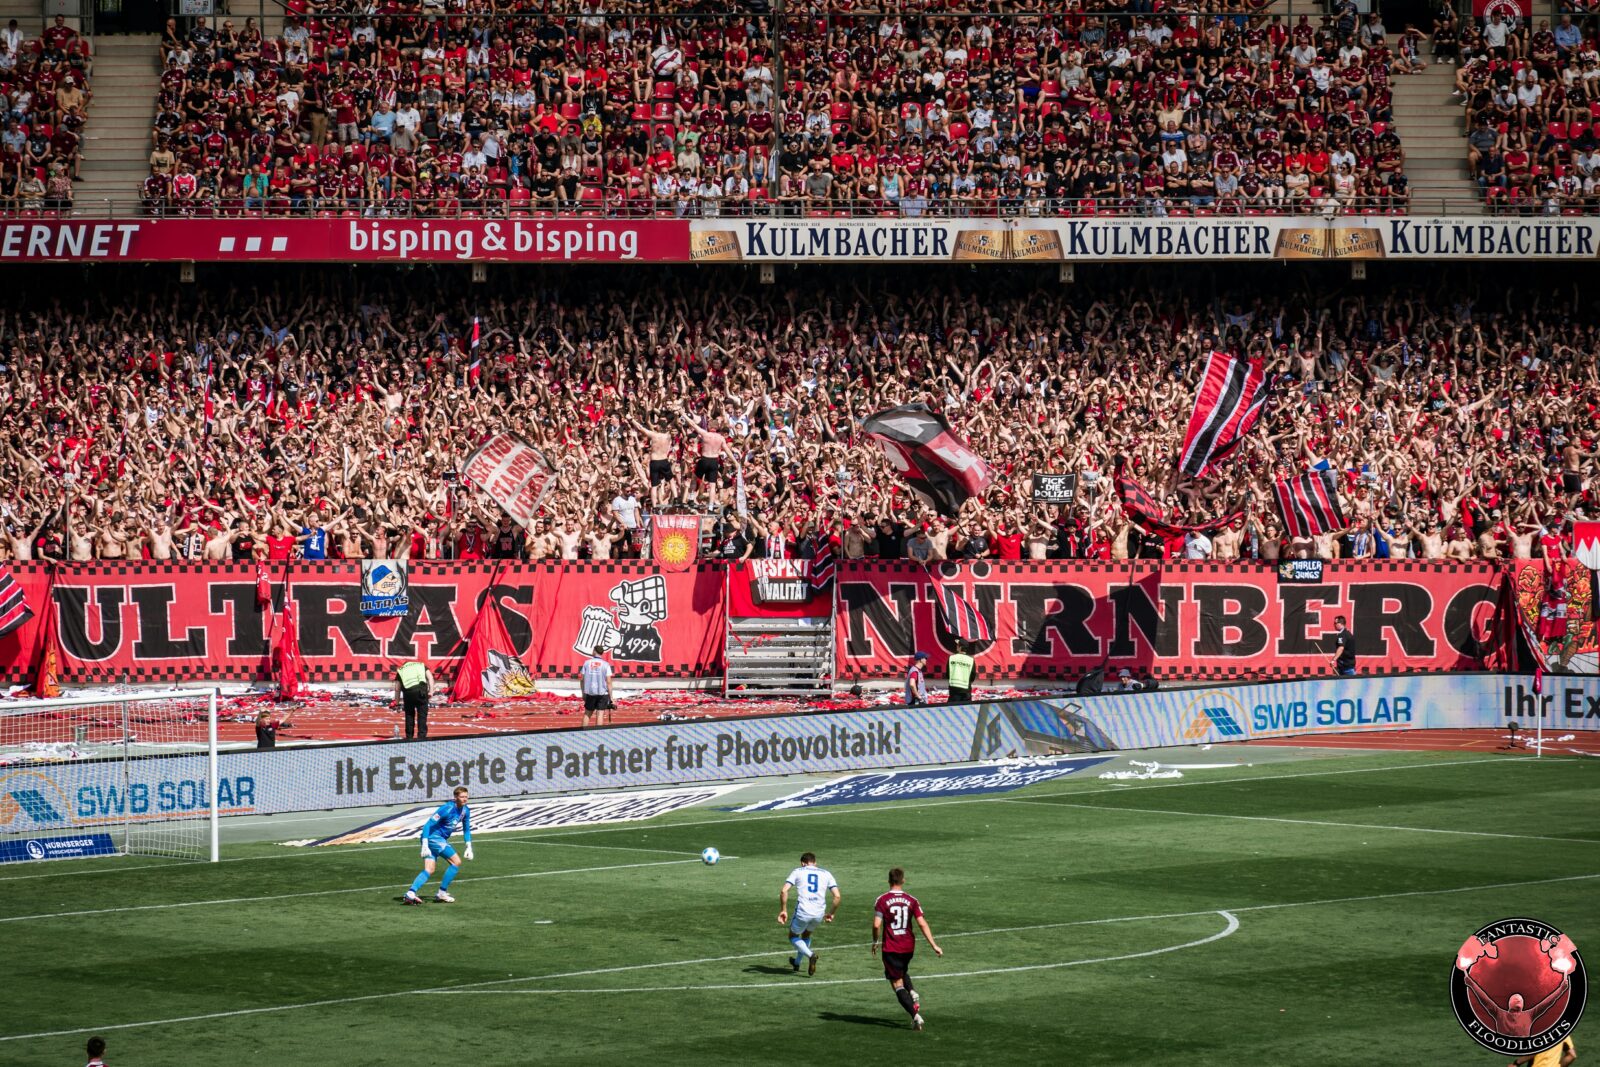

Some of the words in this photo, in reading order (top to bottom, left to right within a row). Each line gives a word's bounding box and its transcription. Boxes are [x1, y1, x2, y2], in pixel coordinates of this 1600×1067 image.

[0, 225, 140, 256] ERNET
[350, 221, 473, 259] bisping
[481, 222, 507, 251] &
[514, 221, 638, 259] bisping
[690, 242, 737, 260] KULMBACHER
[746, 222, 949, 256] KULMBACHER
[1012, 242, 1058, 259] KULMBACHER
[1068, 221, 1271, 255] KULMBACHER
[1390, 220, 1594, 254] KULMBACHER
[466, 432, 518, 485] SEKTION
[491, 447, 542, 504] STADION
[1041, 477, 1066, 485] FICK
[511, 470, 550, 518] VERBO
[1034, 489, 1073, 498] POLIZEI
[751, 559, 810, 577] RESPEKT
[1292, 560, 1322, 571] MARLER
[1295, 571, 1320, 580] JUNGS
[52, 581, 535, 661] ULTRAS
[837, 560, 1501, 659] NÜRNBERG
[360, 596, 409, 611] ULTRAS
[625, 638, 656, 654] 1994
[1254, 701, 1307, 732] SWB
[1317, 696, 1412, 726] SOLAR
[1504, 684, 1553, 717] Ihr
[336, 757, 379, 795] Ihr
[389, 752, 506, 799] Experte
[515, 747, 537, 782] &
[546, 743, 658, 780] Partner
[716, 720, 901, 768] Photovoltaik!
[77, 783, 149, 817] SWB
[157, 776, 255, 811] SOLAR
[807, 873, 819, 893] 9
[890, 905, 909, 930] 31
